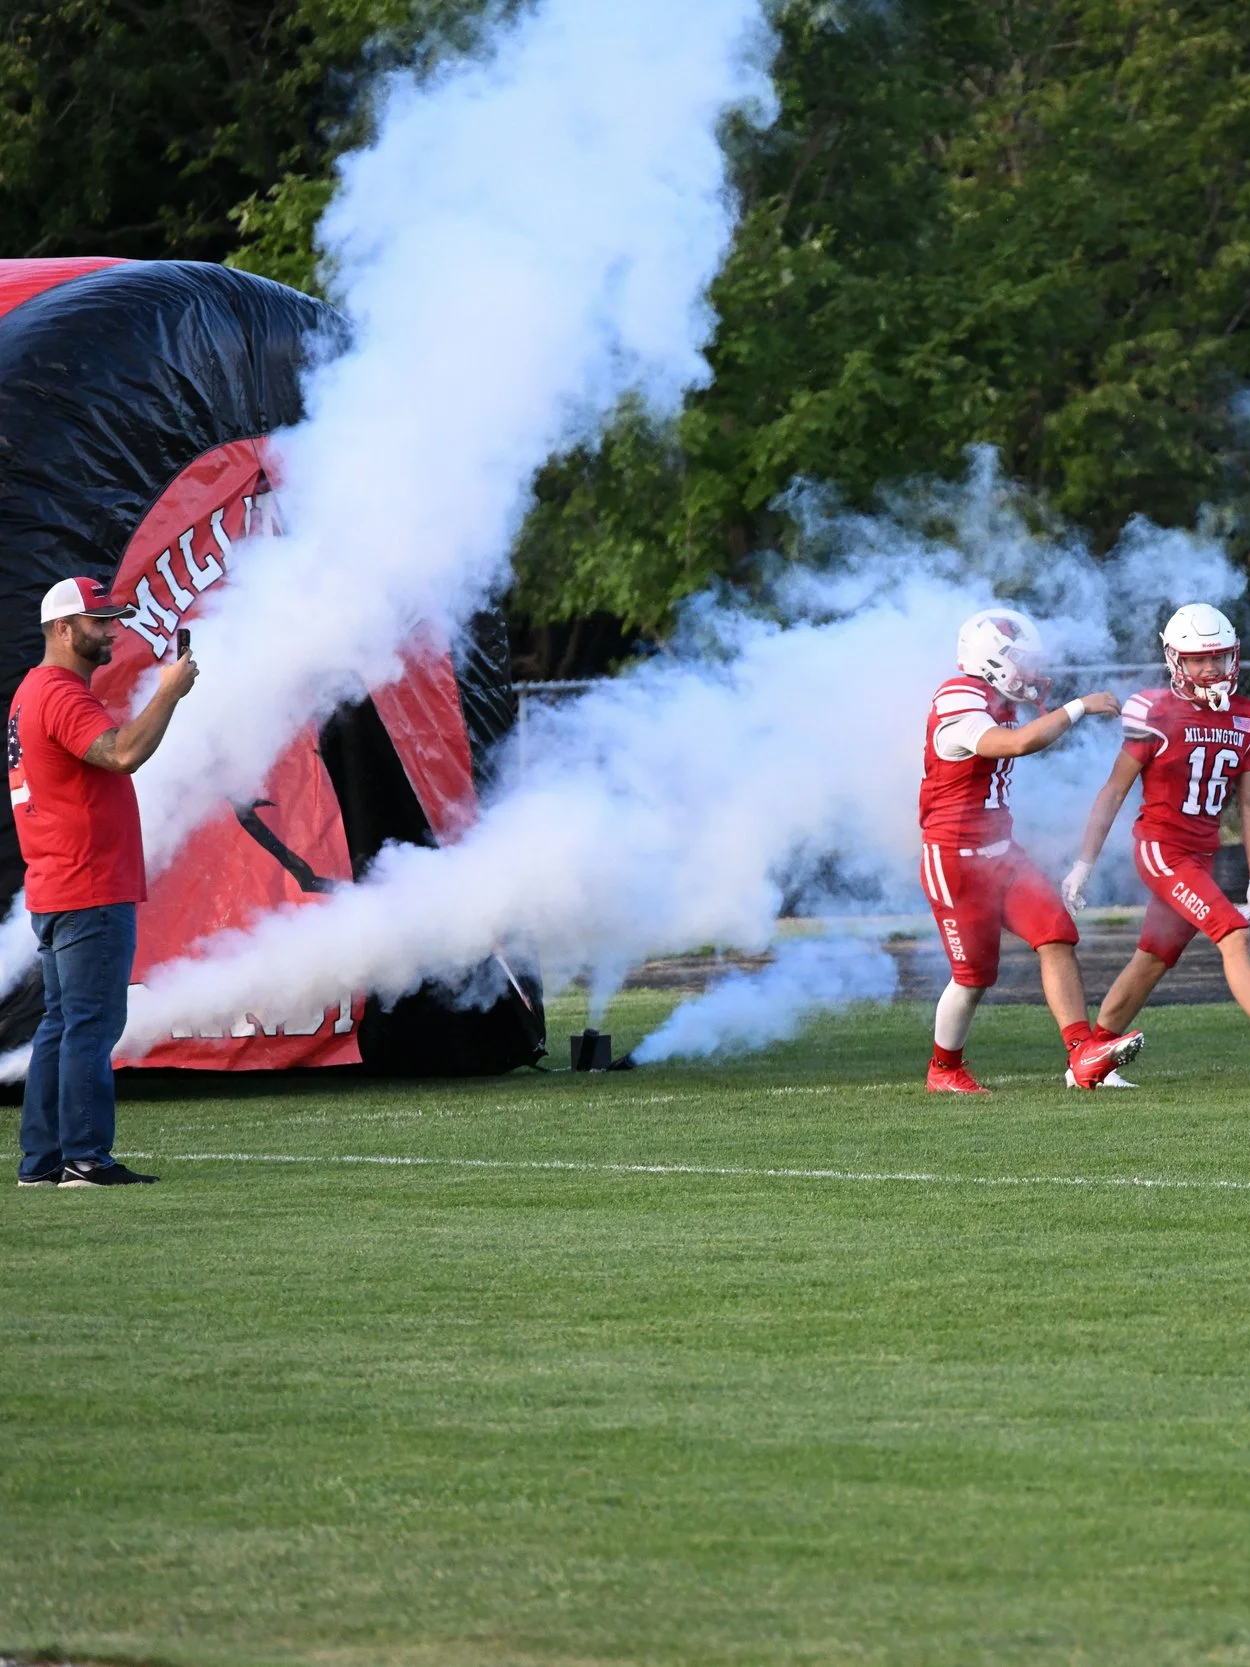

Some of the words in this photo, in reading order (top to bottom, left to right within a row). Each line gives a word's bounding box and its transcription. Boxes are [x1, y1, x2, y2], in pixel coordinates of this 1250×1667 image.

[1184, 727, 1245, 748] MILLINGTON
[1180, 746, 1240, 817] 16
[1171, 881, 1211, 921] CARDS
[942, 918, 967, 961] CARDS
